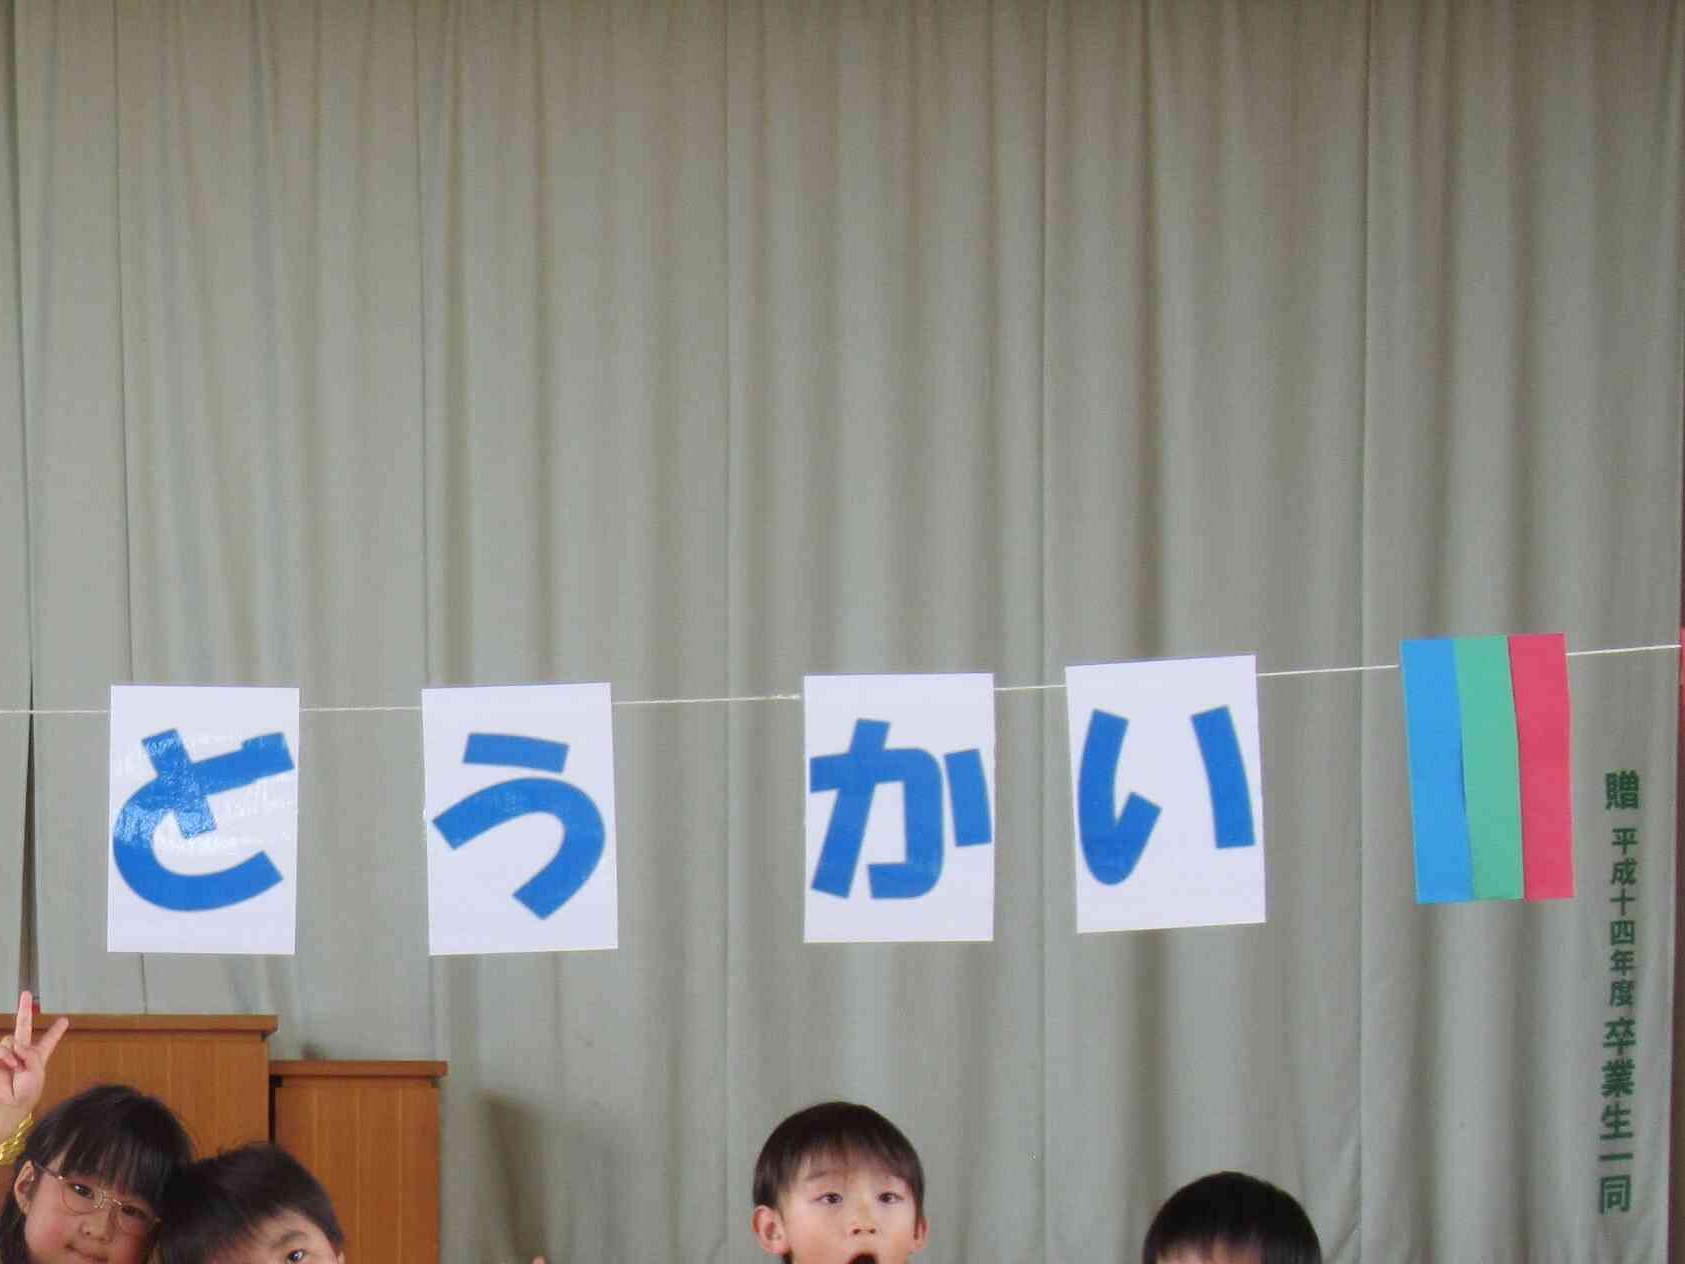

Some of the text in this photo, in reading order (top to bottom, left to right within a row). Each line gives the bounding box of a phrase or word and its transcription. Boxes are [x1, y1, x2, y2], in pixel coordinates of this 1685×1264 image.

[1597, 770, 1640, 1216] 贈 平成十四年度 卒業生一同
